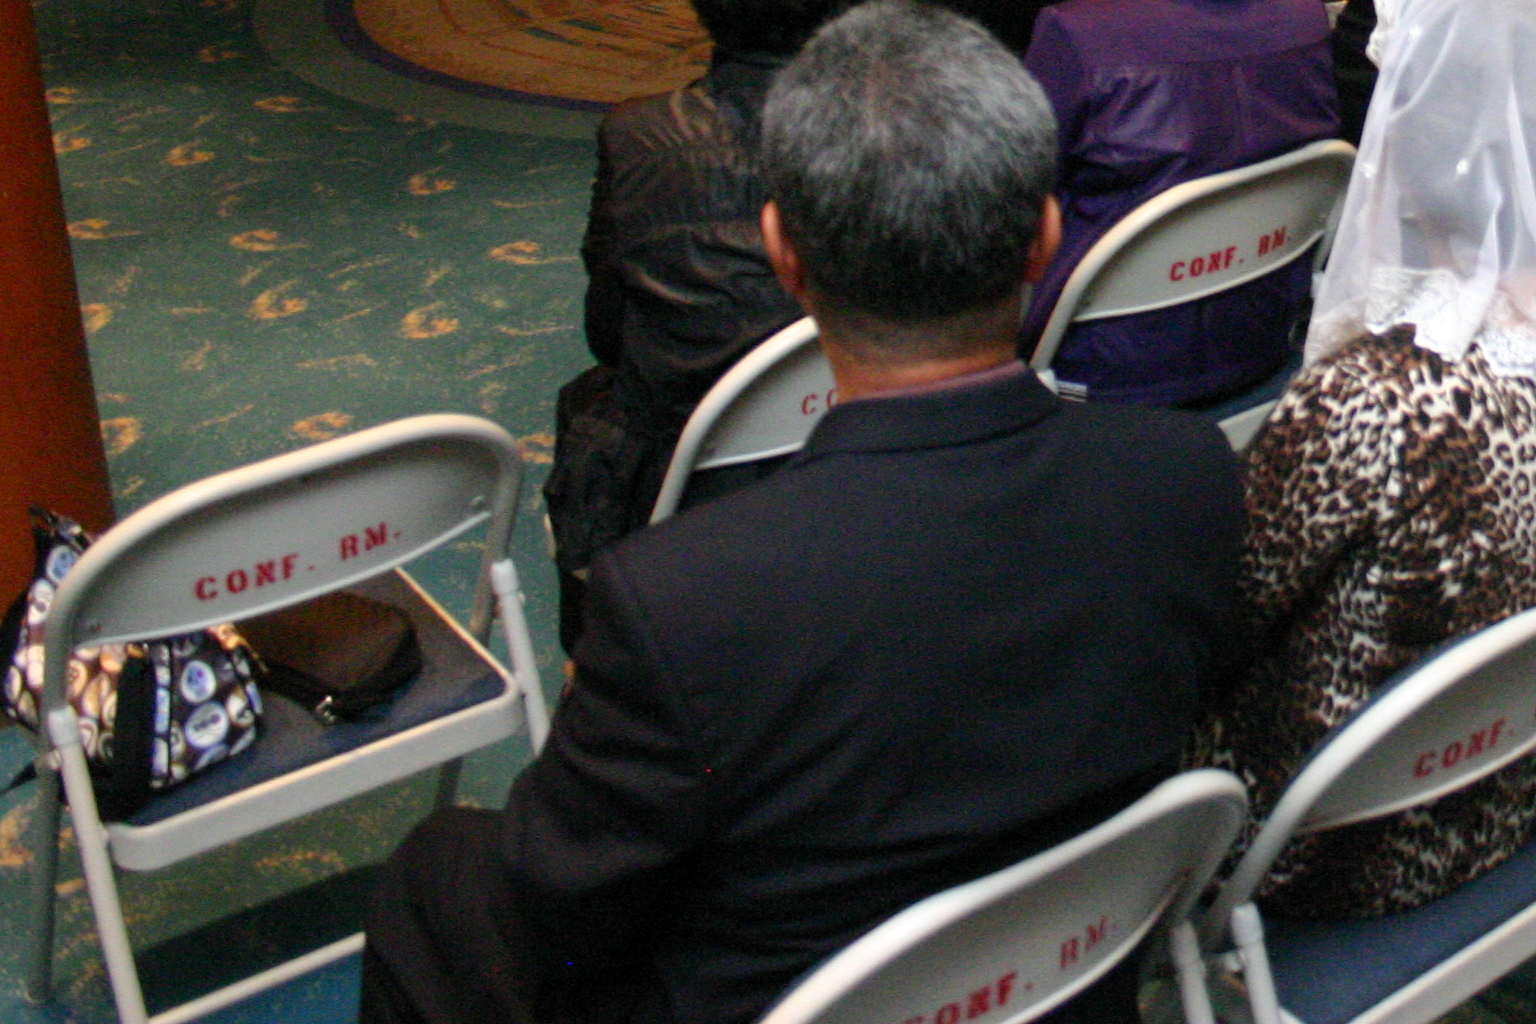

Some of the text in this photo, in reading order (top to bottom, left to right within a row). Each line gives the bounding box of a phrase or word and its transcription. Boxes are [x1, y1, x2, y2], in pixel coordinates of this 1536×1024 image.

[1169, 245, 1244, 282] CONF.
[194, 521, 401, 601] CONF. RM.
[1414, 717, 1514, 778] CONF.
[904, 971, 1034, 1024] ONF.
